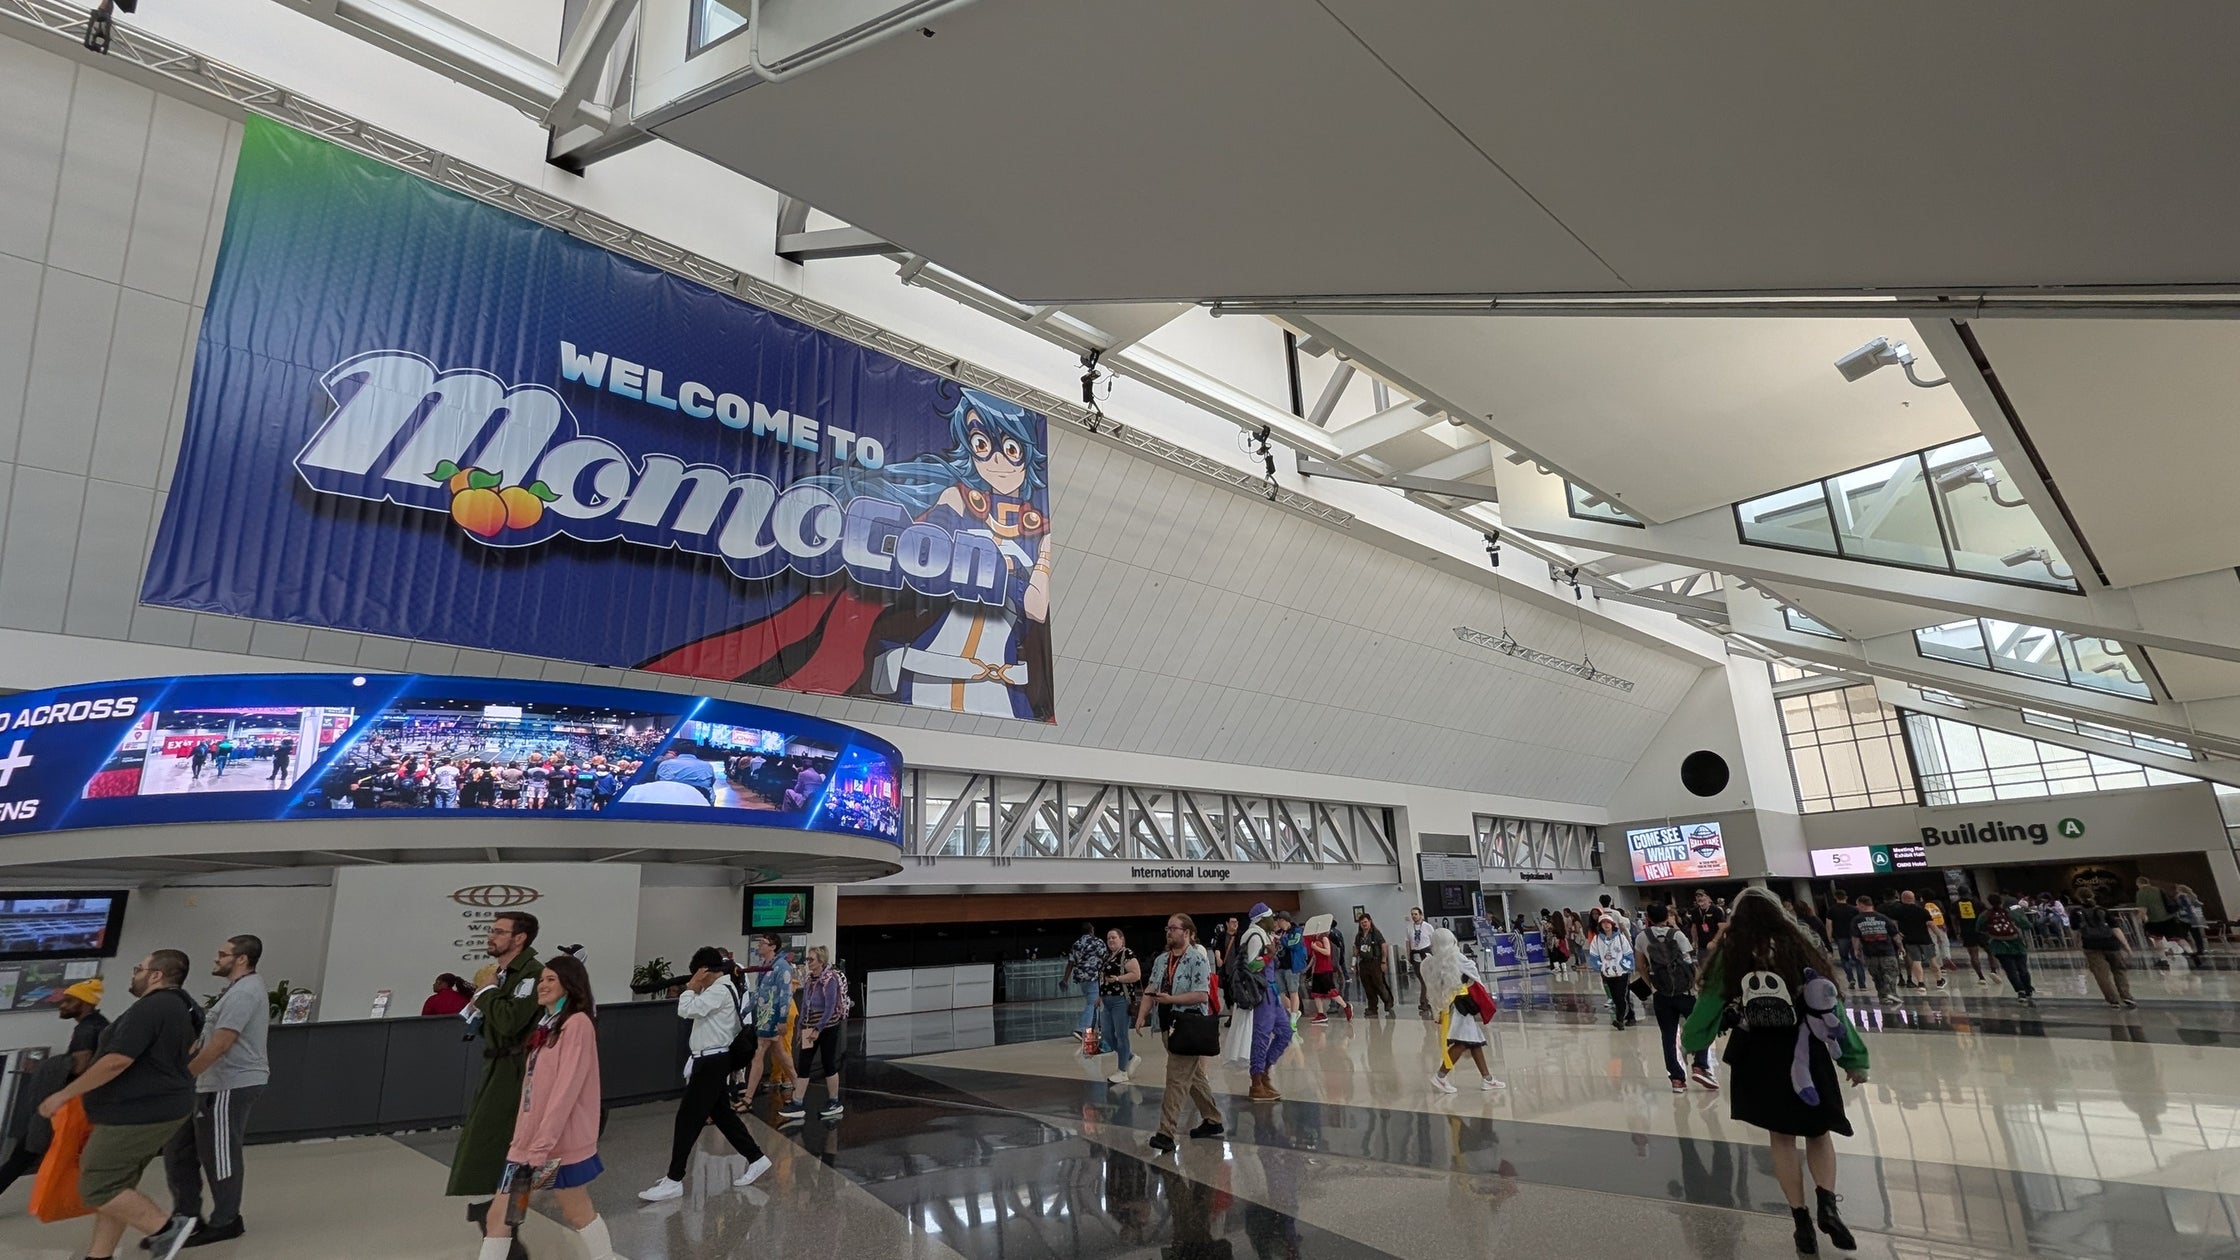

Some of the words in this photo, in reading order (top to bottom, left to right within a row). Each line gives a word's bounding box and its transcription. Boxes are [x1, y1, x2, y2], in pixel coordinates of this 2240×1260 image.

[560, 340, 820, 452] WELCOME
[827, 425, 885, 470] TO
[12, 697, 138, 730] ACROSS
[1633, 830, 1662, 850] COME
[1660, 827, 1681, 844] SEE
[1921, 821, 2048, 847] Building
[2065, 821, 2081, 835] A
[1646, 845, 1687, 862] WHAT'S
[1131, 866, 1194, 878] International
[1197, 866, 1231, 881] Lounge
[1644, 861, 1673, 880] NEW!
